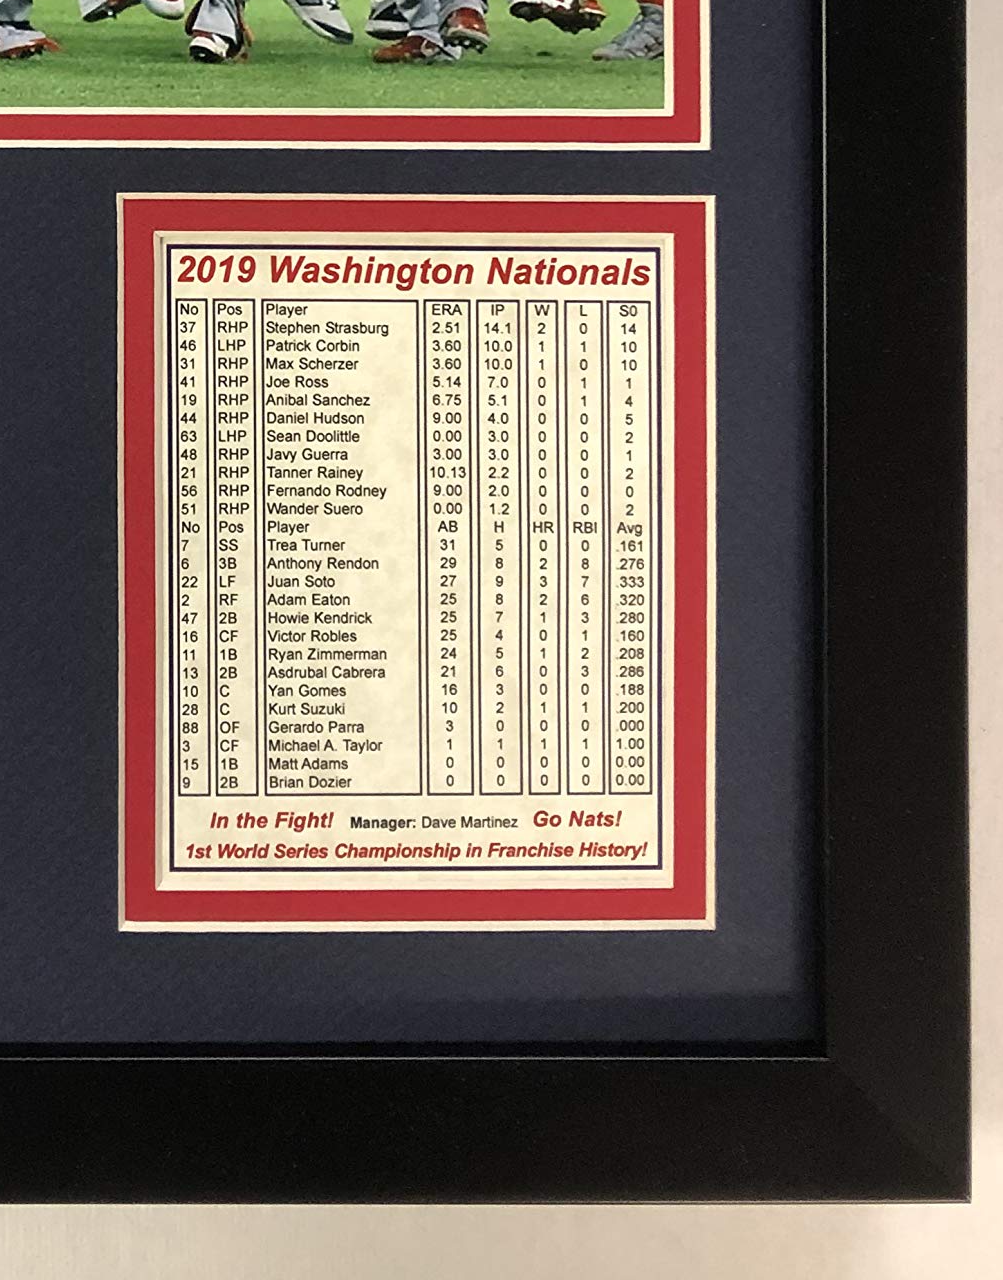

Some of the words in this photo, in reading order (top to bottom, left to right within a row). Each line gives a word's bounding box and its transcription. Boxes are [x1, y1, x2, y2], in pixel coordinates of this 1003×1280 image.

[177, 255, 256, 284] 2019
[271, 255, 474, 291] Washington
[487, 257, 651, 286] Nationals
[180, 304, 199, 315] No
[217, 304, 242, 315] Pos
[266, 304, 308, 318] Player
[432, 304, 463, 316] ERA
[491, 304, 505, 316] IP
[534, 305, 550, 316] W
[580, 305, 588, 316] L
[218, 321, 248, 333] RHP
[266, 321, 320, 336] Stephen
[325, 321, 389, 337] Strasburg
[432, 322, 459, 334] 2.51
[218, 339, 246, 351] LHP
[266, 339, 311, 352] Patrick
[316, 339, 360, 352] Corbin
[432, 340, 461, 352] 3.60
[218, 357, 248, 369] RHP
[266, 357, 294, 370] Max
[299, 357, 359, 370] Scherzer
[432, 358, 461, 370] 3.60
[218, 375, 249, 388] RHP
[266, 376, 290, 388] Joe
[295, 375, 329, 388] Ross
[433, 376, 461, 388] 5.14
[218, 393, 249, 406] RHP
[265, 394, 307, 406] Anibal
[312, 393, 370, 406] Sanchez
[432, 394, 461, 406] 6.75
[218, 412, 249, 424] RHP
[267, 412, 308, 424] Daniel
[314, 412, 364, 424] Hudson
[433, 412, 462, 424] 9.00
[218, 430, 247, 442] LHP
[267, 430, 301, 442] Sean
[306, 430, 360, 442] Doolittle
[433, 430, 462, 442] 0.00
[219, 448, 249, 460] RHP
[266, 448, 297, 463] Javy
[302, 448, 348, 460] Guerra
[433, 448, 462, 460] 3.00
[218, 466, 249, 478] RHP
[266, 466, 313, 479] Tanner
[317, 466, 363, 482] Rainey
[430, 466, 466, 478] 10.13
[219, 484, 249, 497] RHP
[267, 484, 331, 497] Fernando
[336, 484, 387, 500] Rodney
[433, 484, 462, 496] 9.00
[219, 502, 250, 515] RHP
[267, 502, 319, 515] Wander
[323, 502, 363, 515] Suero
[433, 502, 462, 514] 0.00
[182, 521, 200, 533] No
[219, 521, 244, 533] Pos
[268, 520, 310, 536] Player
[438, 520, 458, 533] AB
[494, 521, 504, 533] H
[533, 521, 554, 533] HR
[573, 521, 597, 534] RBI
[617, 522, 642, 537] Avg
[219, 539, 238, 551] SS
[267, 539, 297, 551] Trea
[301, 539, 345, 551] Turner
[219, 557, 237, 569] 3B
[266, 557, 322, 572] Anthony
[327, 557, 379, 569] Rendon
[219, 575, 236, 588] LF
[267, 575, 299, 588] Juan
[305, 575, 335, 588] Soto
[219, 593, 238, 606] RF
[266, 593, 306, 606] Adam
[312, 593, 350, 606] Eaton
[219, 612, 237, 624] 2B
[268, 612, 309, 624] Howie
[314, 612, 372, 624] Kendrick
[219, 630, 239, 643] CF
[267, 630, 306, 642] Victor
[311, 630, 357, 642] Robles
[220, 648, 237, 660] 1B
[269, 648, 302, 663] Ryan
[307, 648, 387, 660] Zimmerman
[220, 666, 237, 679] 2B
[267, 666, 328, 679] Asdrubal
[332, 666, 385, 679] Cabrera
[220, 684, 230, 697] C
[268, 685, 293, 697] Yan
[299, 684, 346, 697] Gomes
[220, 703, 230, 715] C
[269, 703, 296, 715] Kurt
[301, 702, 345, 715] Suzuki
[220, 721, 240, 734] OF
[268, 721, 324, 733] Gerardo
[328, 721, 364, 733] Parra
[220, 739, 239, 752] CF
[269, 739, 320, 752] Michael
[342, 739, 383, 754] Taylor
[221, 757, 238, 770] 1B
[269, 757, 298, 770] Matt
[301, 758, 348, 770] Adams
[220, 776, 238, 789] 2B
[269, 776, 303, 788] Brian
[309, 776, 352, 788] Dozier
[210, 812, 229, 829] In
[237, 812, 268, 828] the
[275, 812, 334, 832] Fight!
[350, 816, 416, 832] Manager:
[422, 816, 456, 828] Dave
[461, 816, 518, 828] Martinez
[533, 810, 561, 827] Go
[569, 810, 622, 827] Nats!
[186, 844, 212, 859] 1st
[218, 843, 270, 859] World
[274, 843, 328, 859] Series
[335, 843, 461, 862] Championship
[466, 843, 482, 858] in
[488, 842, 574, 858] Franchise
[579, 842, 648, 860] History!
